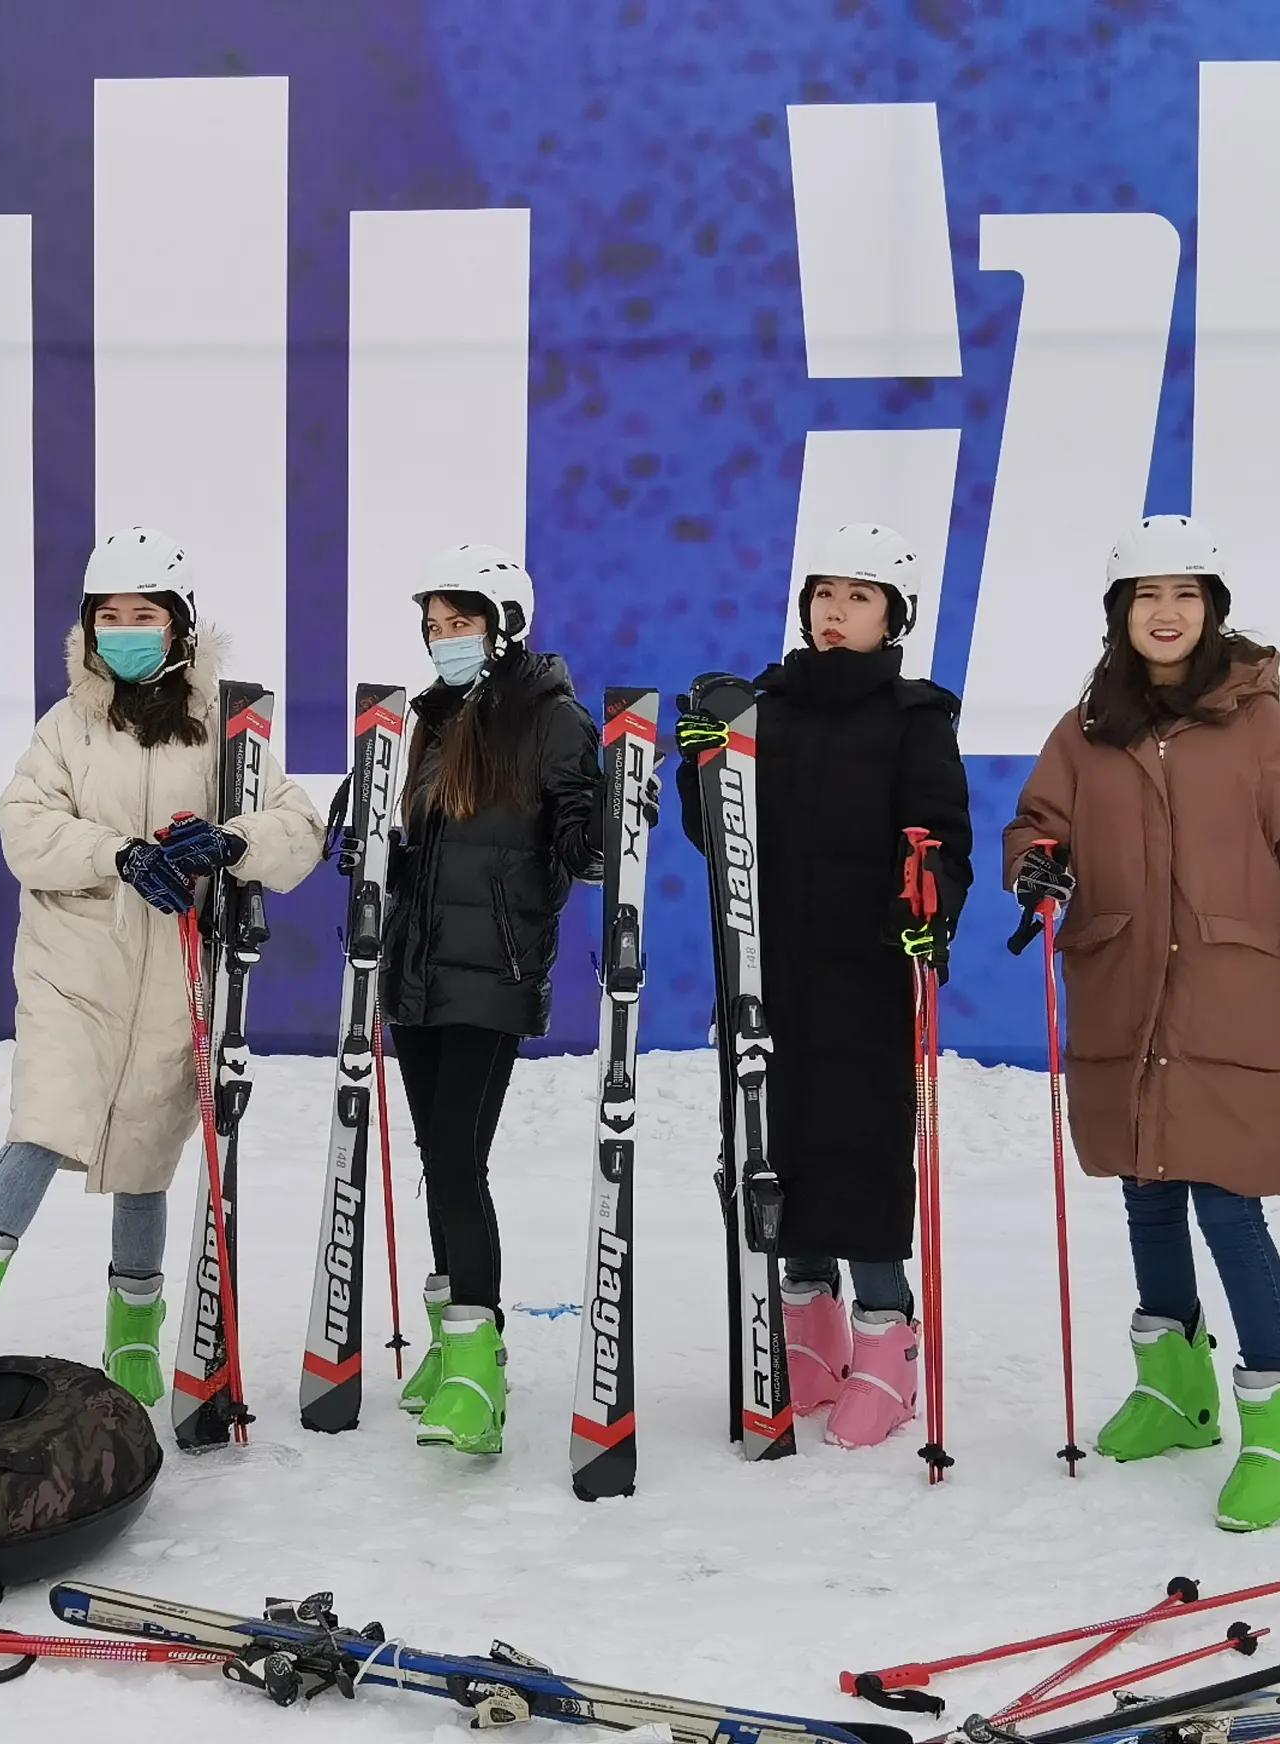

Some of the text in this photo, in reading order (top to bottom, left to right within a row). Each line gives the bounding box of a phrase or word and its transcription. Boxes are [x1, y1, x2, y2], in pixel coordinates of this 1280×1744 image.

[245, 736, 261, 812] RT
[370, 733, 393, 844] RTX
[623, 742, 644, 863] RTX
[719, 767, 755, 937] hagan
[745, 946, 758, 970] 148
[335, 1145, 348, 1170] 148
[599, 1193, 612, 1219] 148
[324, 1176, 362, 1347] hagan
[590, 1226, 628, 1406] hagan
[751, 1292, 771, 1410] RTX
